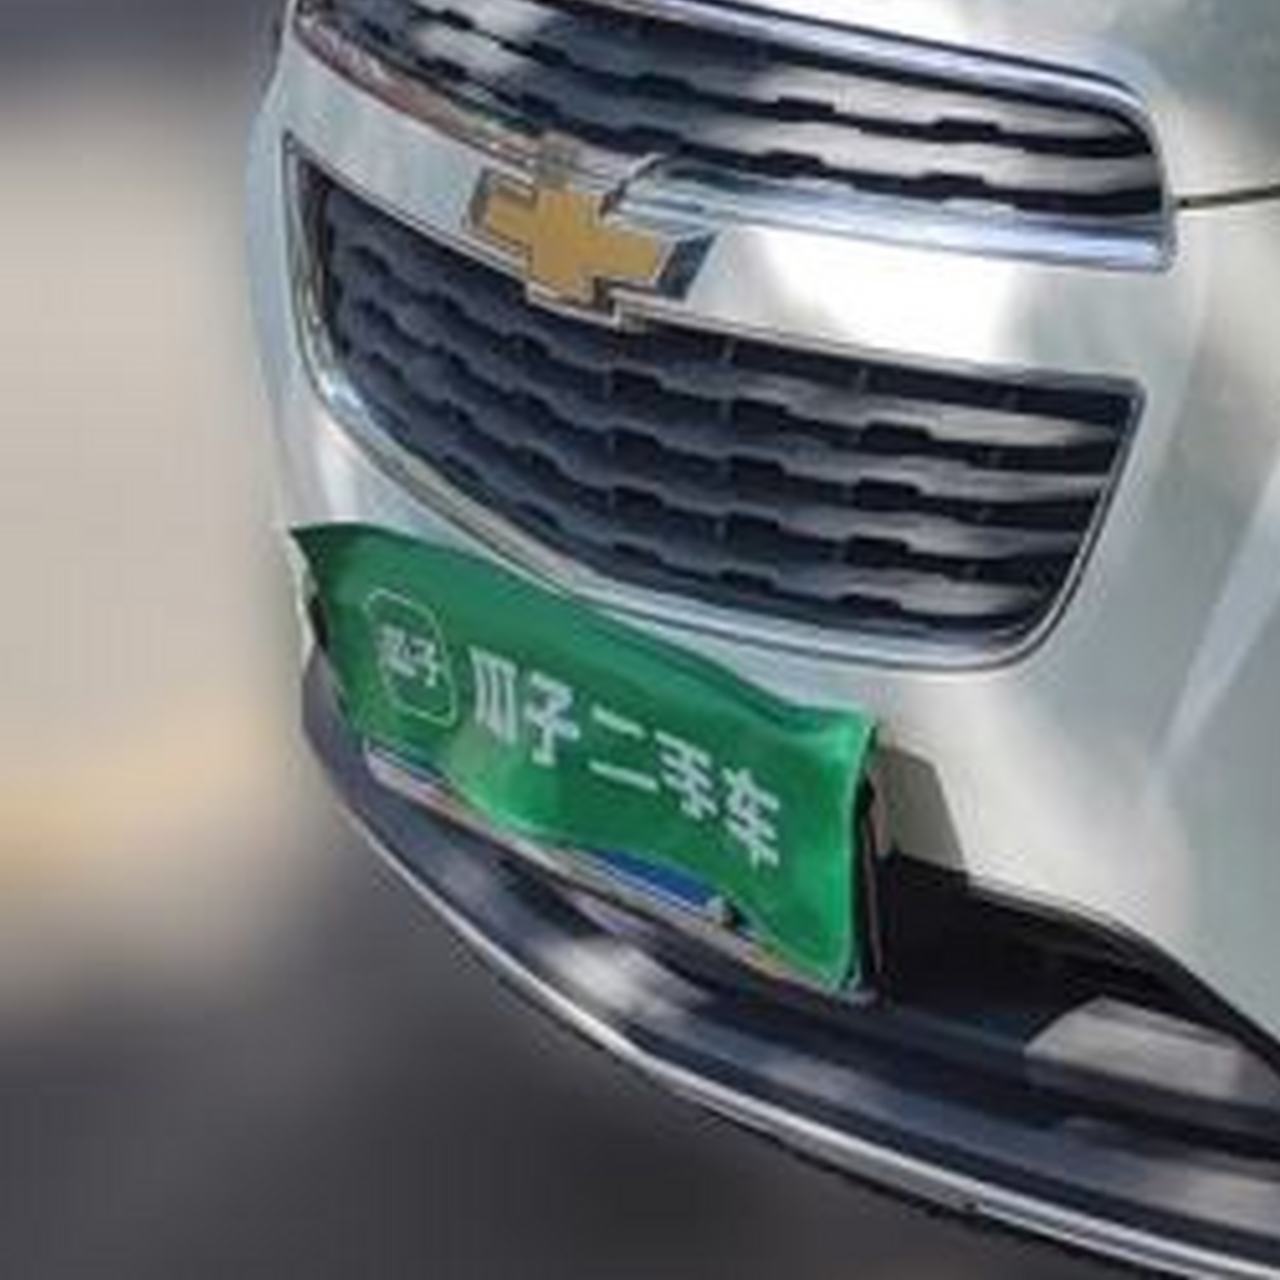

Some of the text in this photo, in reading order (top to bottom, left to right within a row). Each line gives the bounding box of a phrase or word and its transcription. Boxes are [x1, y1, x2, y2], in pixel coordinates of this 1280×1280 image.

[468, 645, 781, 870] 瓜子二手车
